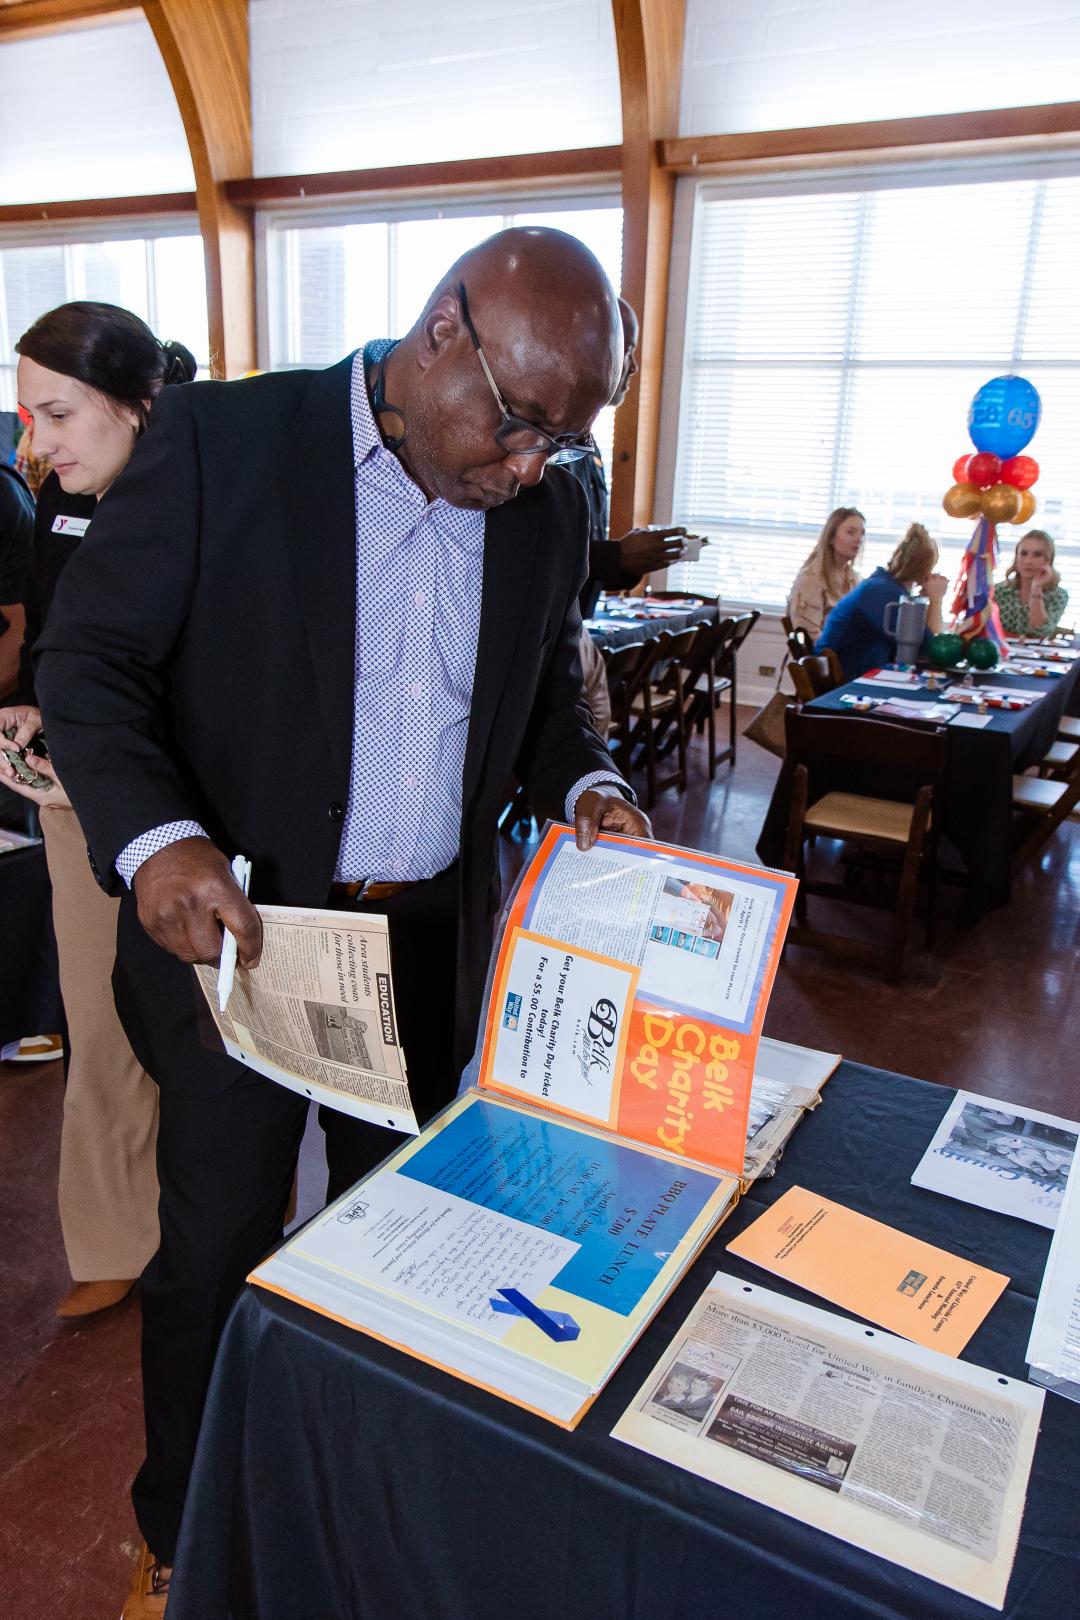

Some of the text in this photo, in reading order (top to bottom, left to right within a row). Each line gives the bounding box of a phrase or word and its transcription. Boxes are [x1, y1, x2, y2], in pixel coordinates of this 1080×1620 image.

[331, 930, 349, 1004] for those in need
[347, 934, 359, 1002] collecting coats
[360, 935, 371, 996] Area students
[378, 977, 393, 1042] EDUCATION
[511, 995, 523, 1016] United
[520, 956, 549, 1079] For a $5.00 Contribution to
[536, 1009, 548, 1038] today!
[542, 955, 573, 1097] Get your Belk Charity Day ticket
[584, 998, 618, 1072] Belk
[631, 1013, 674, 1089] Day
[703, 1036, 740, 1111] Belk
[658, 1024, 705, 1153] Charity
[342, 1205, 365, 1220] APE
[540, 1162, 601, 1225] 11:30 A.M. To 2:00
[597, 1193, 616, 1209] April
[608, 1207, 638, 1236] $ 7.00
[573, 1219, 592, 1237] 2006
[598, 1181, 687, 1285] BBQ PLATE LUNCH
[944, 1301, 958, 1317] Lincoln
[957, 1288, 967, 1297] Way
[964, 1275, 976, 1289] United
[932, 1317, 948, 1333] County
[706, 1305, 727, 1318] More
[731, 1315, 749, 1326] than
[752, 1322, 782, 1338] $3,000
[783, 1336, 810, 1350] raised
[812, 1345, 825, 1356] for
[828, 1352, 859, 1369] United
[861, 1364, 879, 1377] Way
[937, 1394, 986, 1417] Christmas
[749, 1403, 765, 1412] FOR
[774, 1413, 812, 1432] INSURANCE
[774, 1425, 814, 1444] INSURANCE
[815, 1441, 843, 1456] AGENCY
